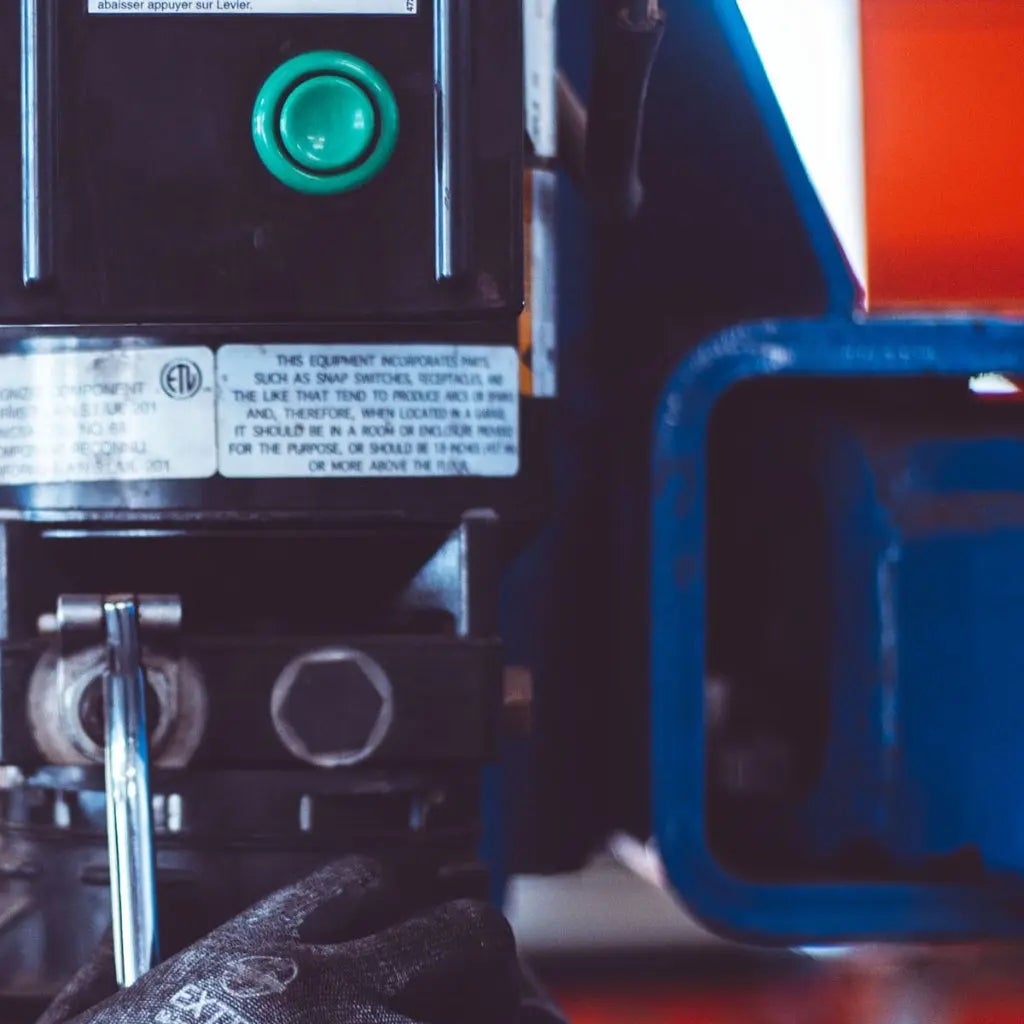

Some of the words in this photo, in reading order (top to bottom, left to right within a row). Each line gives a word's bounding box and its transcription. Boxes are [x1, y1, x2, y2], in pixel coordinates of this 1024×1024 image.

[97, 0, 144, 10] abaisser
[147, 1, 192, 11] appuyer
[195, 2, 214, 10] sur
[276, 354, 304, 367] THIS
[309, 354, 375, 368] EQUIPMENT
[254, 372, 288, 385] SUCH
[293, 372, 310, 385] AS
[316, 372, 348, 385] SNAP
[232, 389, 256, 402] THE
[262, 389, 289, 402] LIKE
[296, 389, 328, 402] THAT
[335, 389, 367, 402] TEND
[372, 389, 388, 401] TO
[283, 407, 356, 421] THEREFORE,
[361, 407, 395, 420] WHEN
[398, 407, 448, 420] LOCATED
[235, 425, 247, 438] IT
[253, 425, 304, 438] SHOULD
[309, 425, 324, 438] BE
[330, 425, 342, 437] IN
[347, 426, 357, 437] A
[361, 425, 395, 438] ROOM
[399, 425, 415, 438] OR
[228, 442, 253, 455] FOR
[259, 442, 281, 455] THE
[348, 442, 364, 455] OR
[369, 442, 412, 455] SHOULD
[307, 460, 326, 473] OR
[331, 460, 363, 472] MORE
[369, 460, 407, 472] ABOVE
[413, 460, 432, 472] THE
